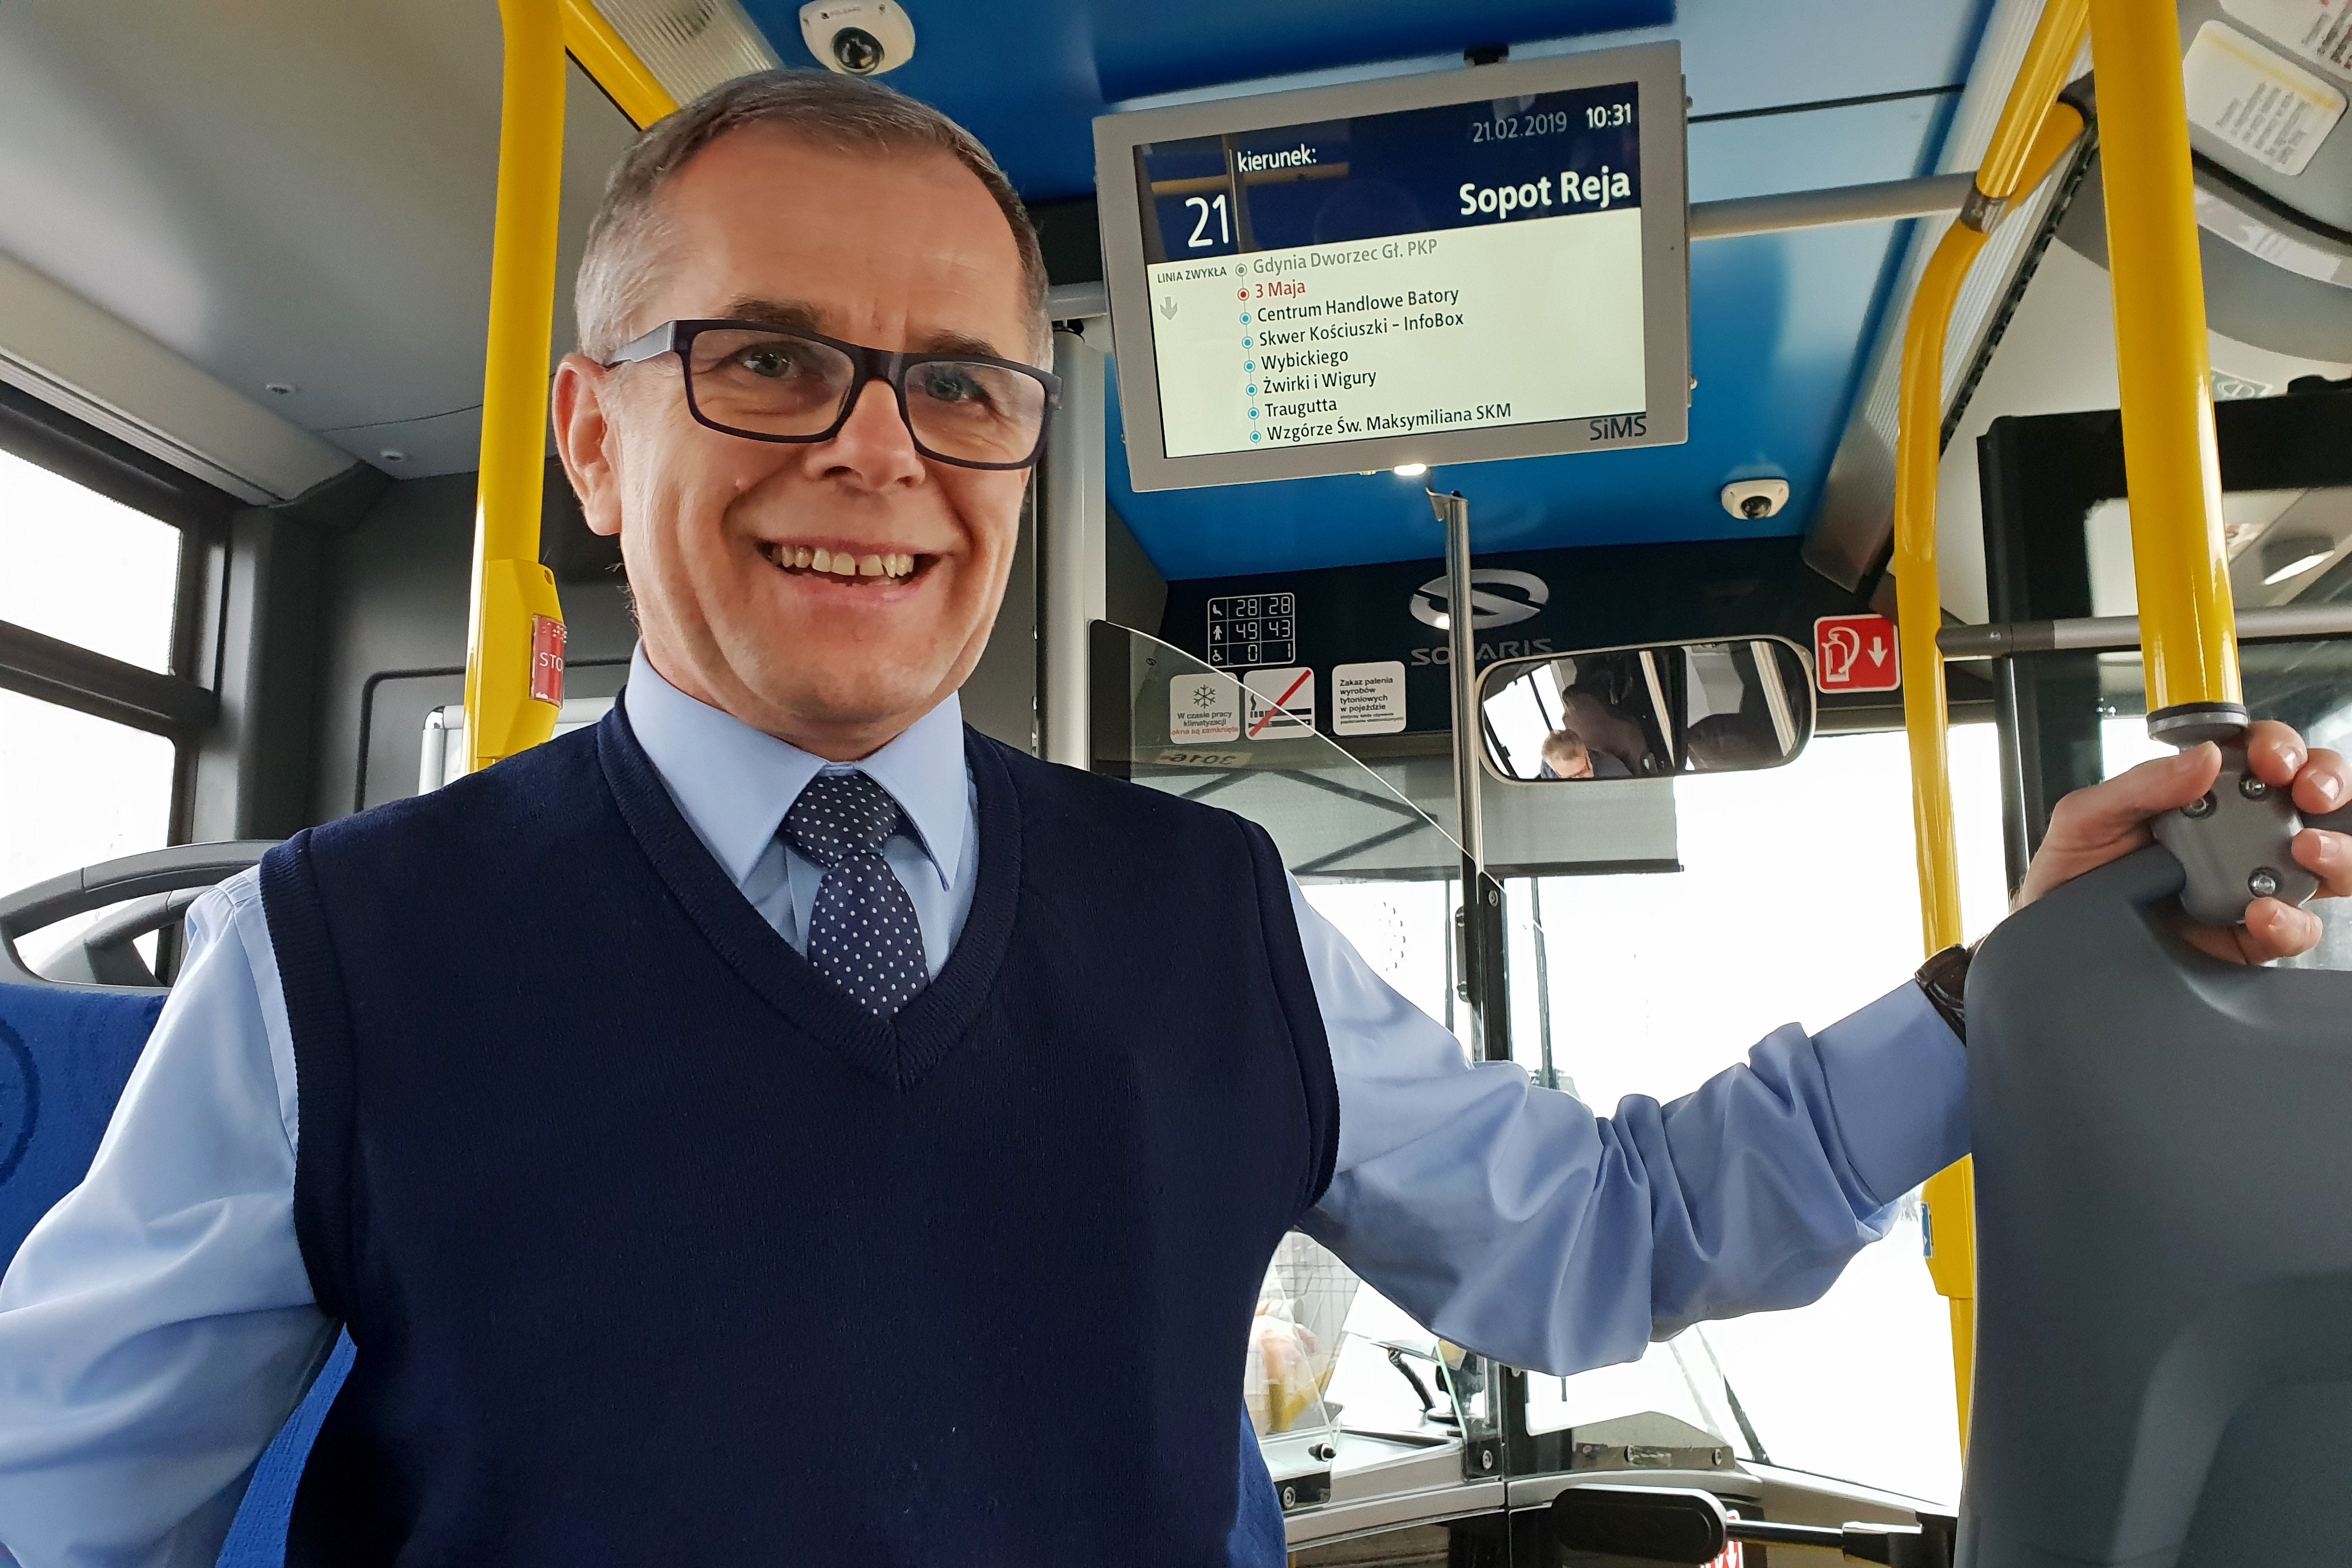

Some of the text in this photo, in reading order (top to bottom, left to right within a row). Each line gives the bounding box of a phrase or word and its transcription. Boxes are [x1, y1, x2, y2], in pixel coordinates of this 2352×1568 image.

[1473, 103, 1631, 142] 21.02.2019 10:31
[1237, 144, 1317, 172] kierunek:
[1460, 164, 1631, 219] Sopot Reja
[1185, 194, 1229, 247] 21
[1254, 239, 1437, 276] Gdynia Dworzec Gł. PKP
[1157, 266, 1227, 284] LINIA ZWYKŁA
[1255, 279, 1306, 299] 3 Maja
[1258, 289, 1459, 322] Centrum Handlowe Batory
[1259, 329, 1306, 346] Skwer
[1310, 318, 1387, 341] Kościuszki
[1404, 313, 1464, 331] InfoBox
[1261, 349, 1349, 373] Wybickiego
[1263, 371, 1377, 394] Żwirki i Wigury
[1265, 398, 1338, 418] Traugutta
[1266, 403, 1511, 442] Wzgórze Św. Maksymiliana SKM
[1590, 415, 1647, 440] SiMS
[1236, 596, 1290, 617] 28 28
[1236, 620, 1290, 639] 49 43
[1248, 643, 1291, 662] 0 1
[1410, 638, 1552, 666] SOARIS
[1340, 687, 1376, 696] wyrobów
[1365, 677, 1394, 686] palenia
[1340, 694, 1388, 705] tytoniowych
[1349, 704, 1386, 713] pojeździe
[1183, 719, 1226, 727] klimatyzacji
